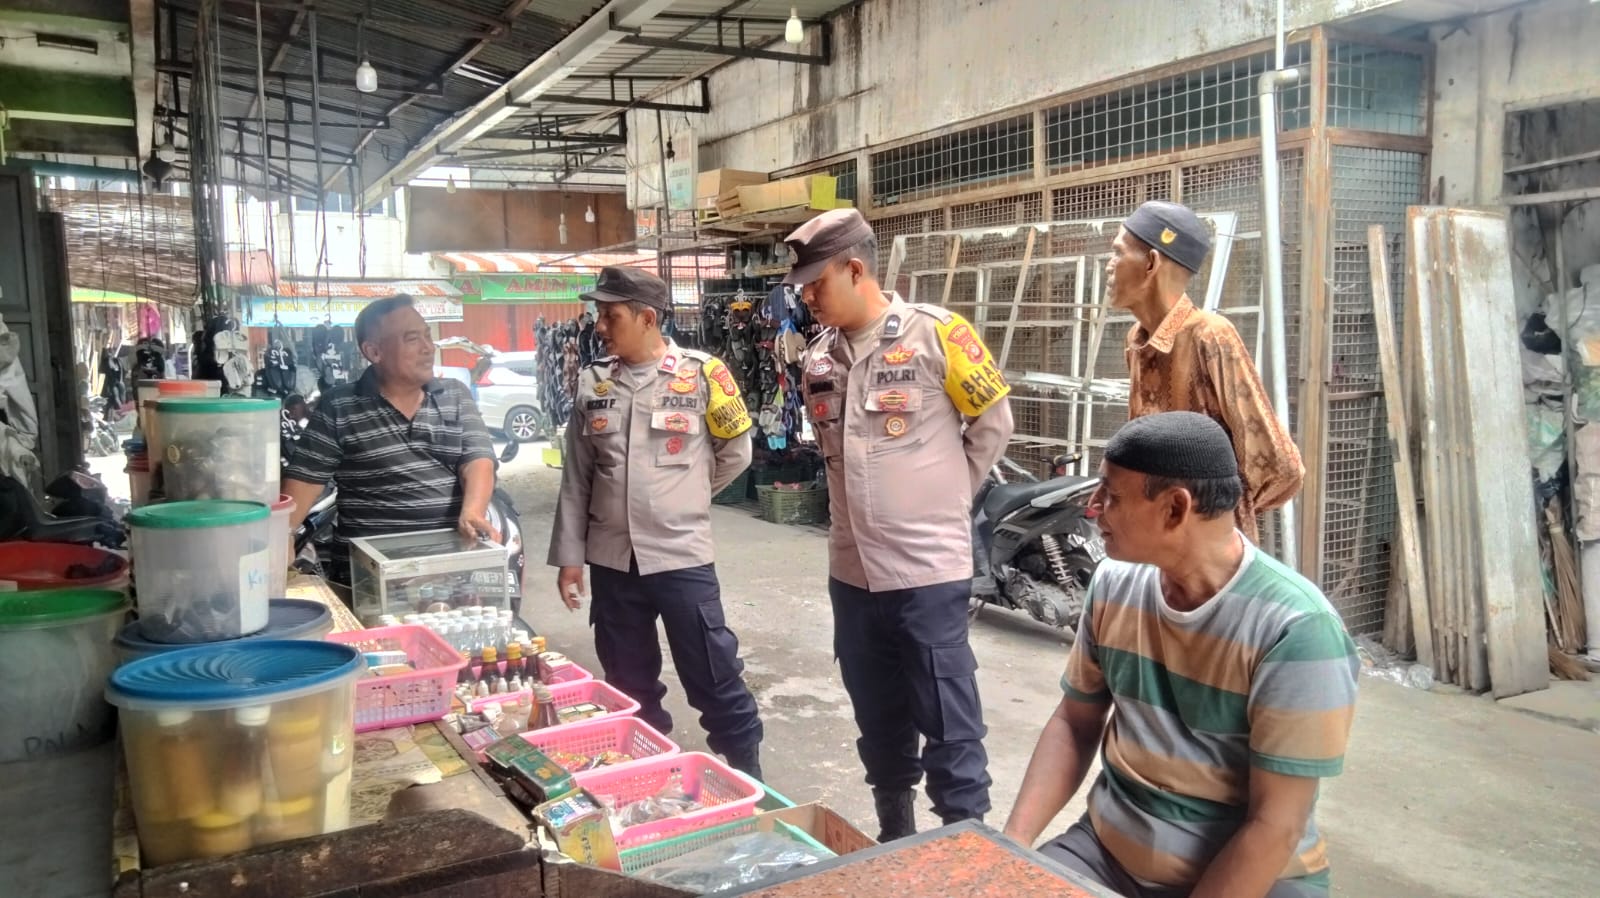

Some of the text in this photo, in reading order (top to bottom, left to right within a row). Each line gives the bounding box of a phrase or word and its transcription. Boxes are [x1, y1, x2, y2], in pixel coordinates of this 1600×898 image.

[506, 278, 568, 294] AMIN
[876, 368, 917, 384] POLRI
[662, 396, 698, 409] POLRI
